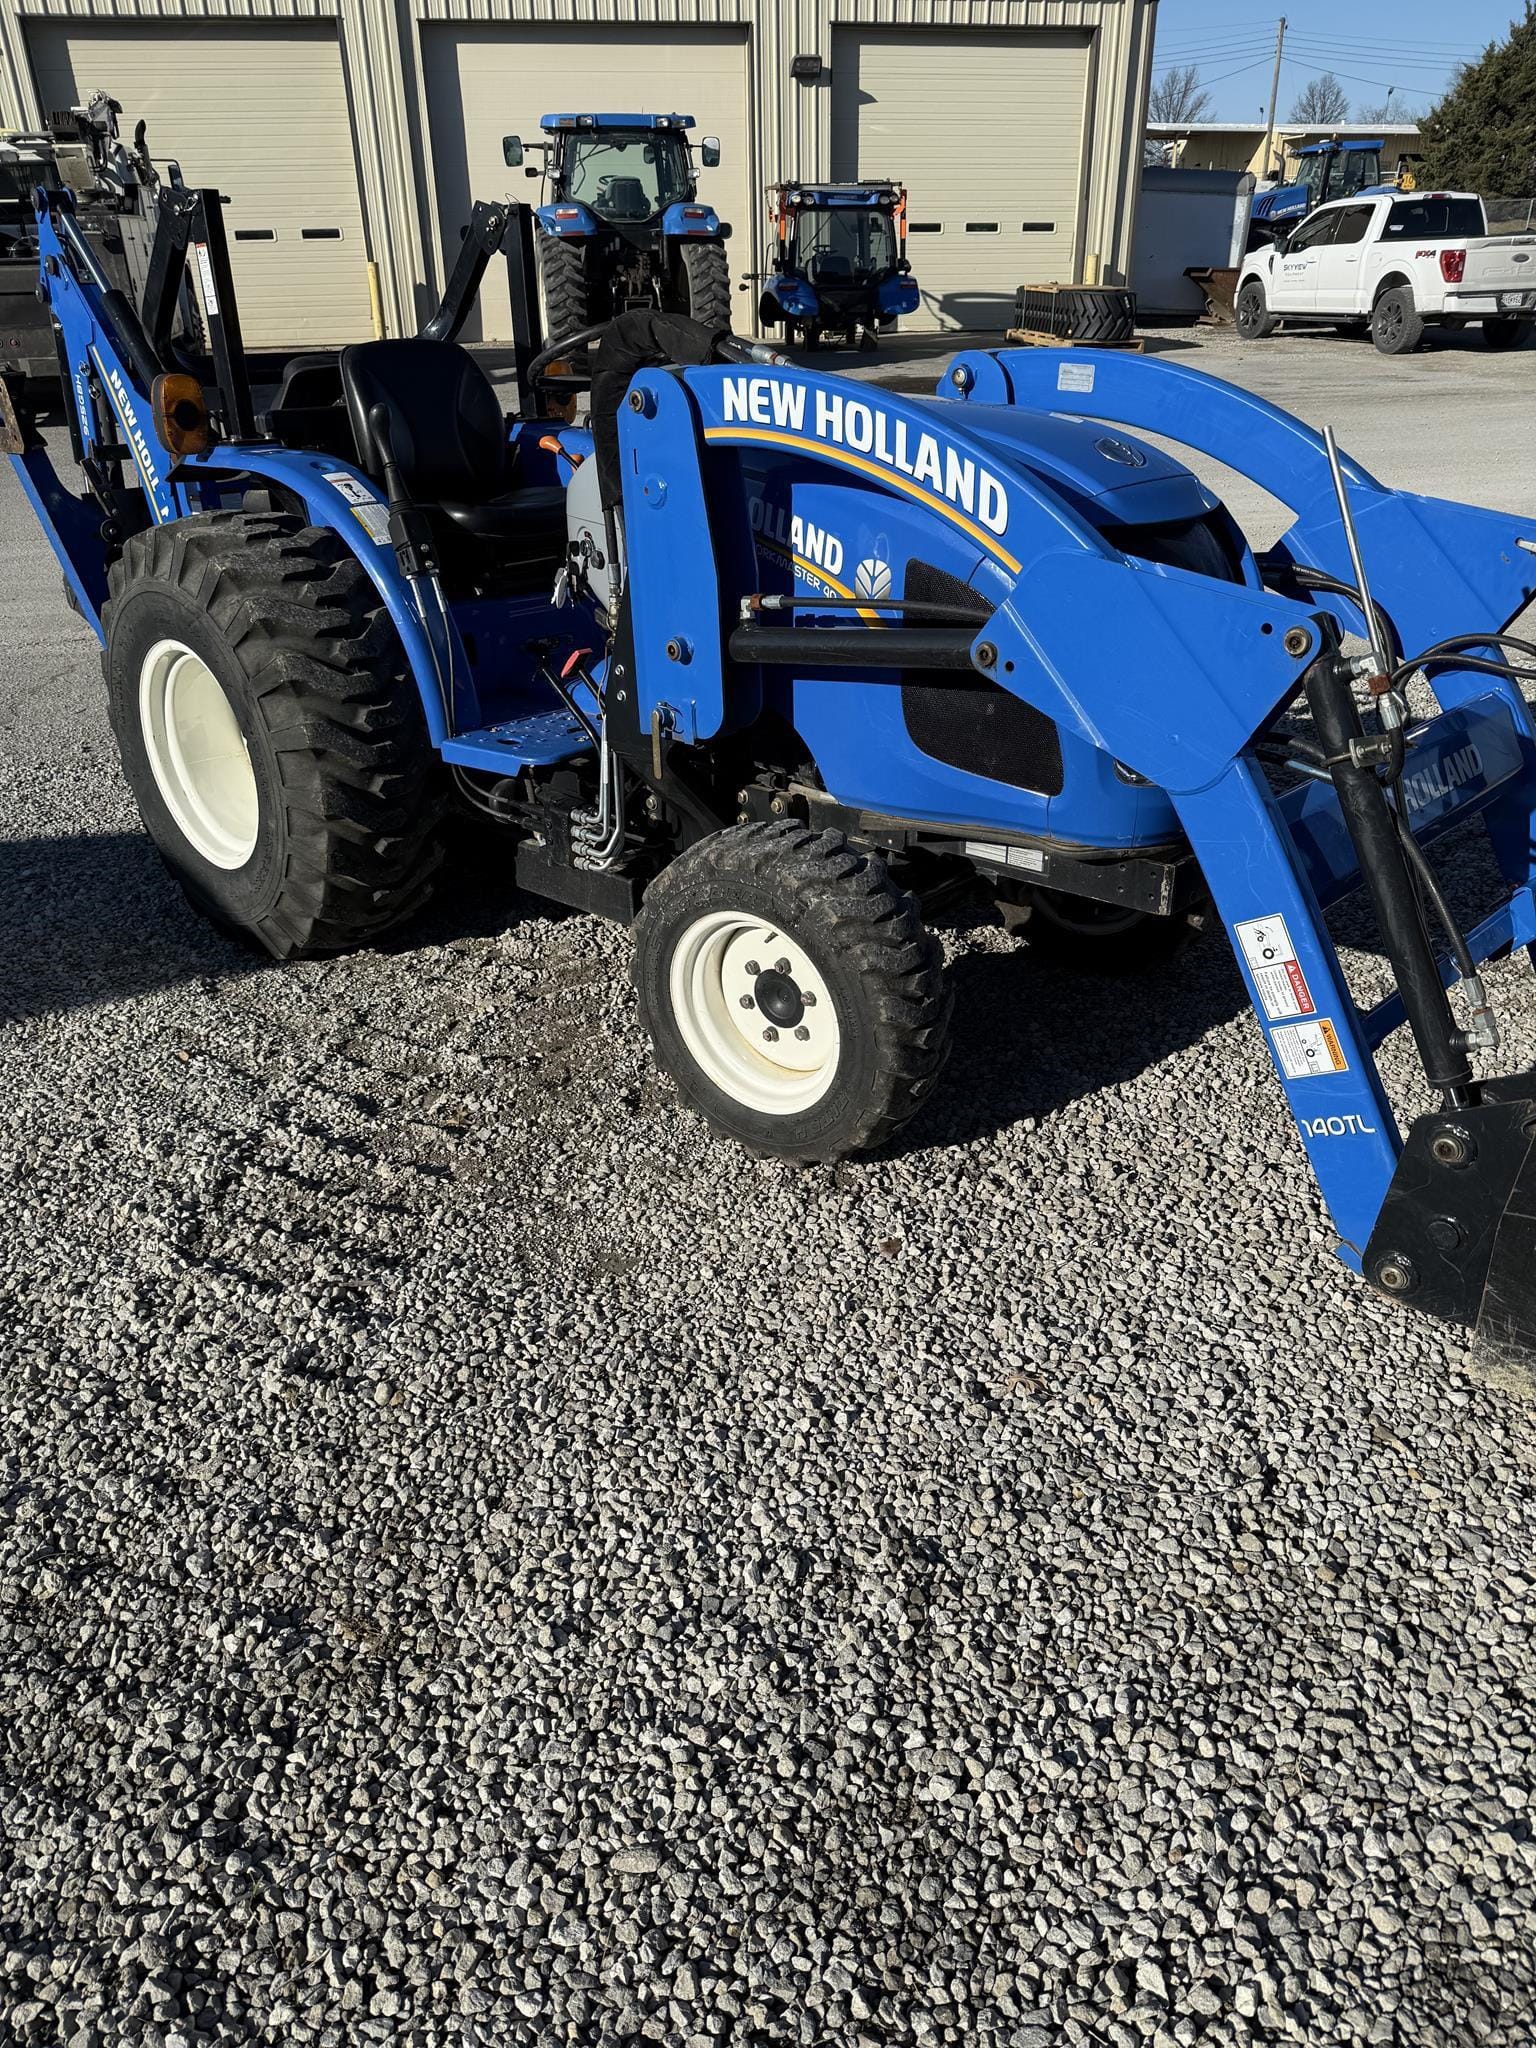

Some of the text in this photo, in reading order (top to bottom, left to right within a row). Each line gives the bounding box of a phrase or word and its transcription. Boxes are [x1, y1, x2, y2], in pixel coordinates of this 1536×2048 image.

[110, 368, 138, 428] NEW
[722, 377, 1009, 536] NEW HOLLAND
[748, 496, 843, 576] OLLAND
[1403, 743, 1484, 814] HOLLAND
[1291, 973, 1310, 1010] DANGER
[1326, 1031, 1342, 1066] WARNING
[1300, 1114, 1376, 1138] 140TL
